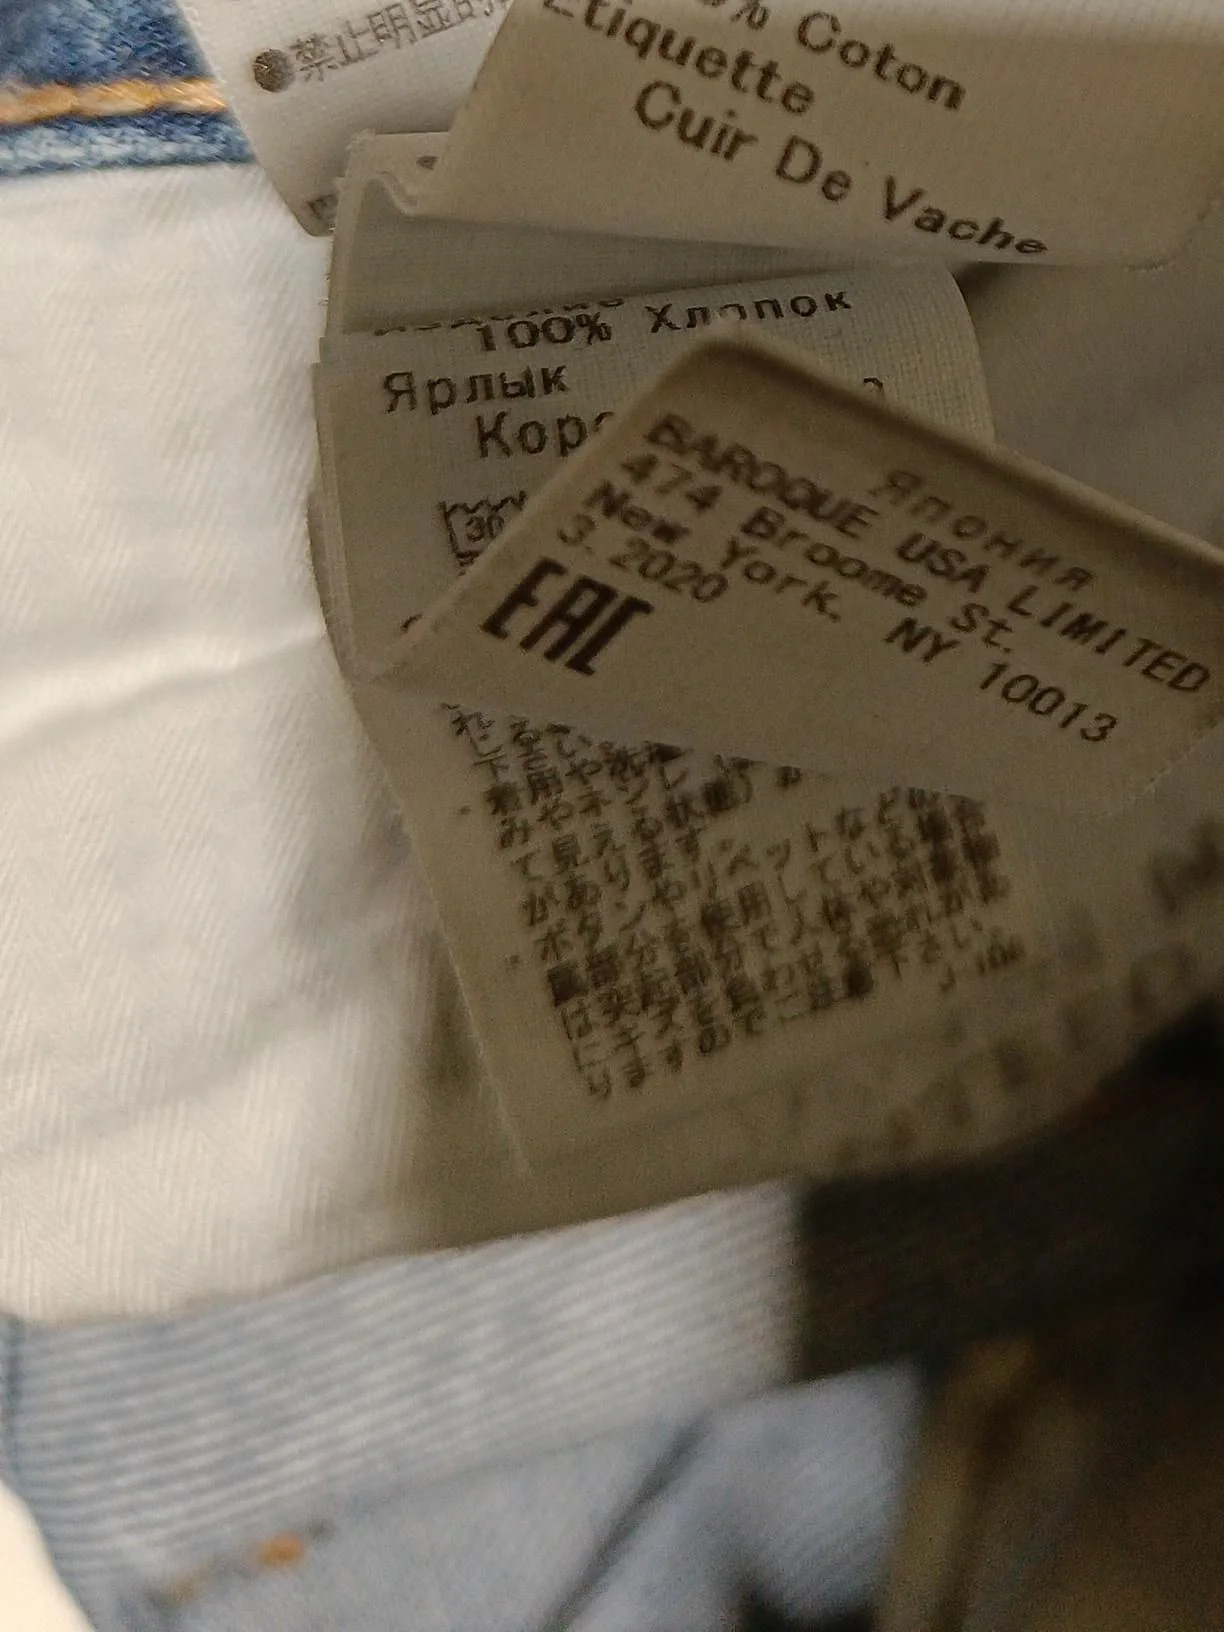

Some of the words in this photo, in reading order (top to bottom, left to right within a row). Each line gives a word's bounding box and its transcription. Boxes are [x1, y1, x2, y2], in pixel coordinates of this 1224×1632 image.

[797, 12, 966, 112] Coton
[634, 80, 758, 161] Cuir
[775, 137, 852, 202] De
[882, 176, 1048, 255] Vache
[383, 365, 569, 414] Ярлык
[477, 312, 612, 351] 100%
[611, 537, 728, 602] 2020
[620, 452, 722, 512] 474
[742, 507, 928, 607] Broome
[950, 600, 1012, 656] St.
[645, 413, 880, 538] BAROQUE
[900, 530, 991, 594] USA
[1006, 584, 1211, 694] LIMITED
[868, 471, 1094, 592] Япония
[582, 482, 691, 544] New
[886, 617, 959, 665] NY
[981, 663, 1119, 743] 10013
